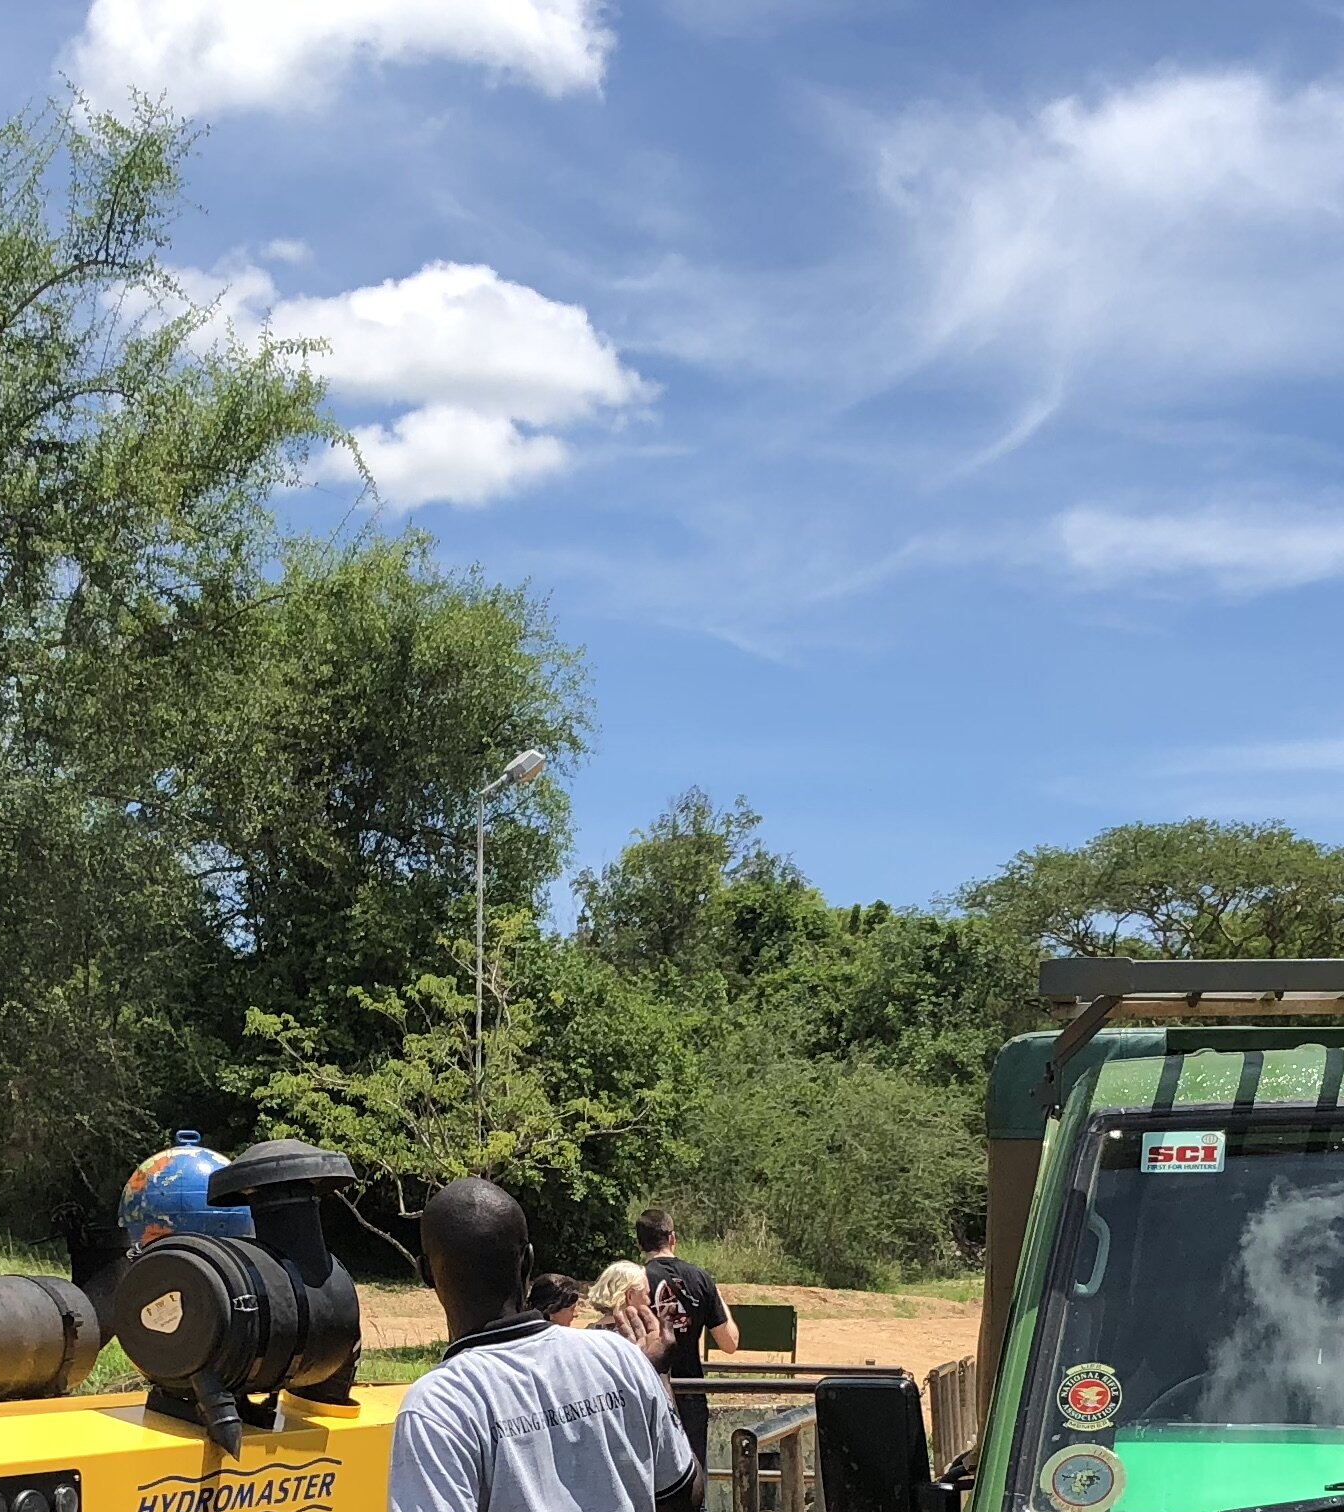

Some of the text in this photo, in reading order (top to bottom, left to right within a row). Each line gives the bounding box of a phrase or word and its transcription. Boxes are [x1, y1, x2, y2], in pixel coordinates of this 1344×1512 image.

[1148, 1146, 1218, 1163] SCI
[1060, 1371, 1119, 1397] NATIONAL RIFLE
[1061, 1402, 1117, 1421] ASSOCIATION
